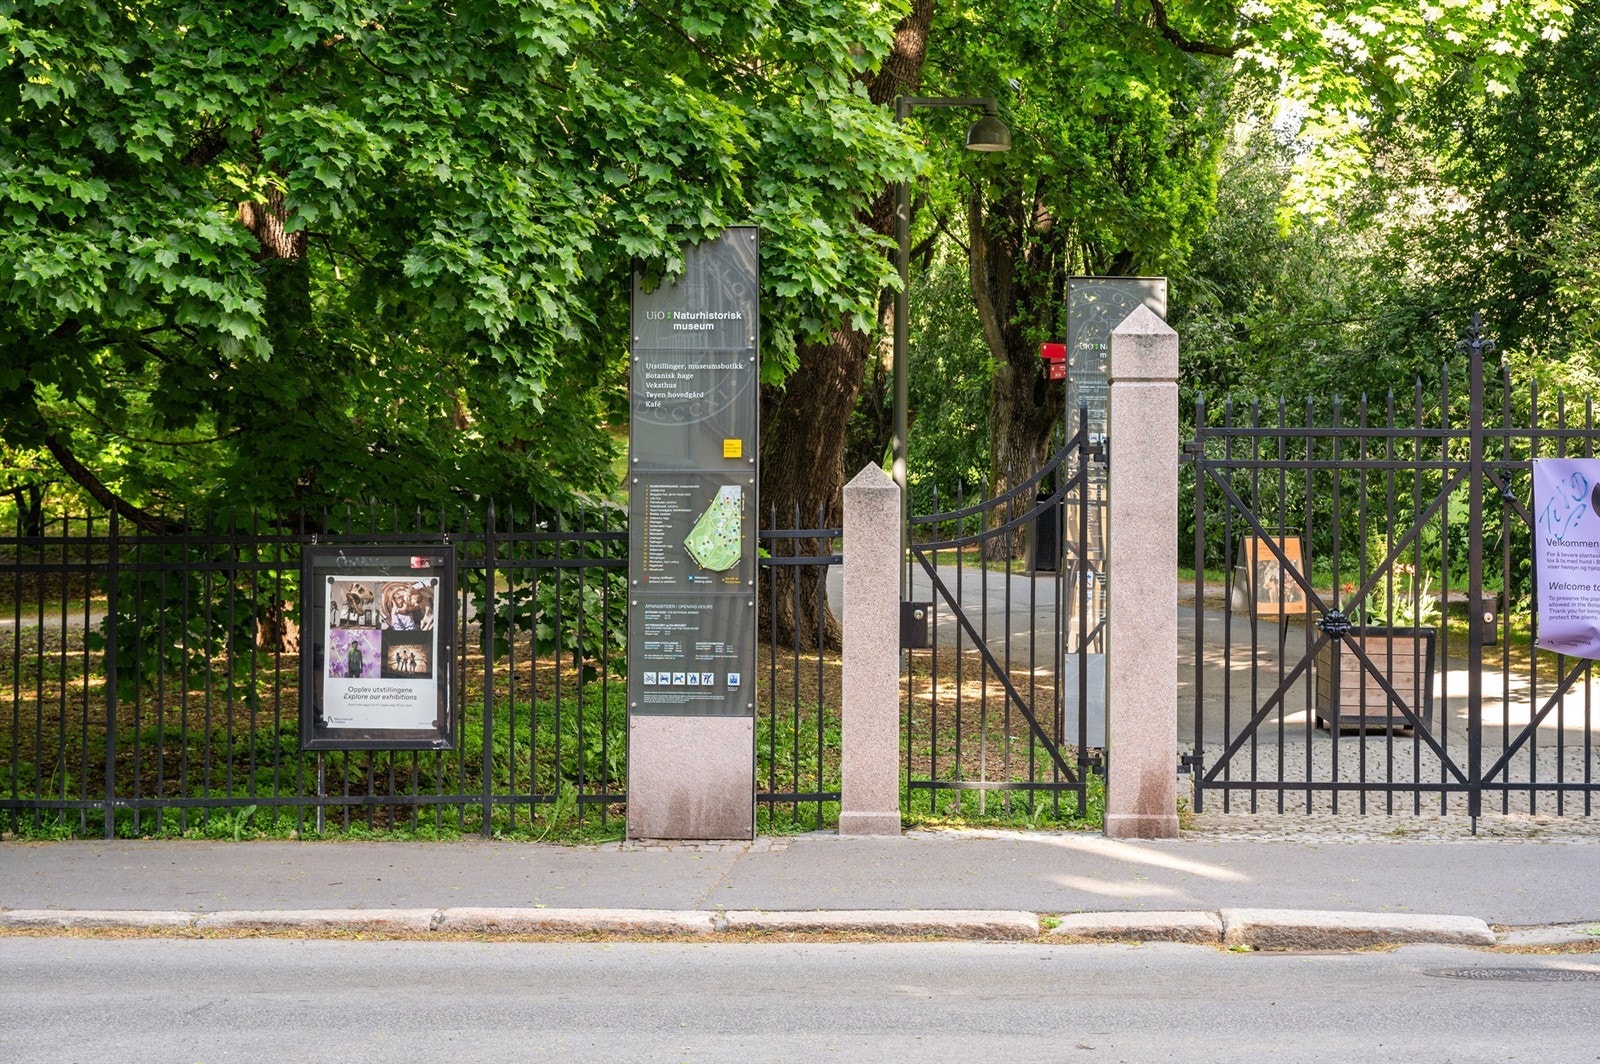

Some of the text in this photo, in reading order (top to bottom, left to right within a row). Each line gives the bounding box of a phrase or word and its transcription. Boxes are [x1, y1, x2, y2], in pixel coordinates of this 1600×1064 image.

[673, 311, 742, 320] Naturhistorisk
[645, 362, 744, 371] Utstillinger, museumsbutikk
[677, 372, 694, 381] hage
[645, 391, 704, 399] Tøyen hovedgård
[645, 400, 662, 408] Kafé
[1545, 538, 1599, 548] Velkommen
[1548, 582, 1591, 591] Welcome
[348, 686, 413, 694] Opplev utstillingene
